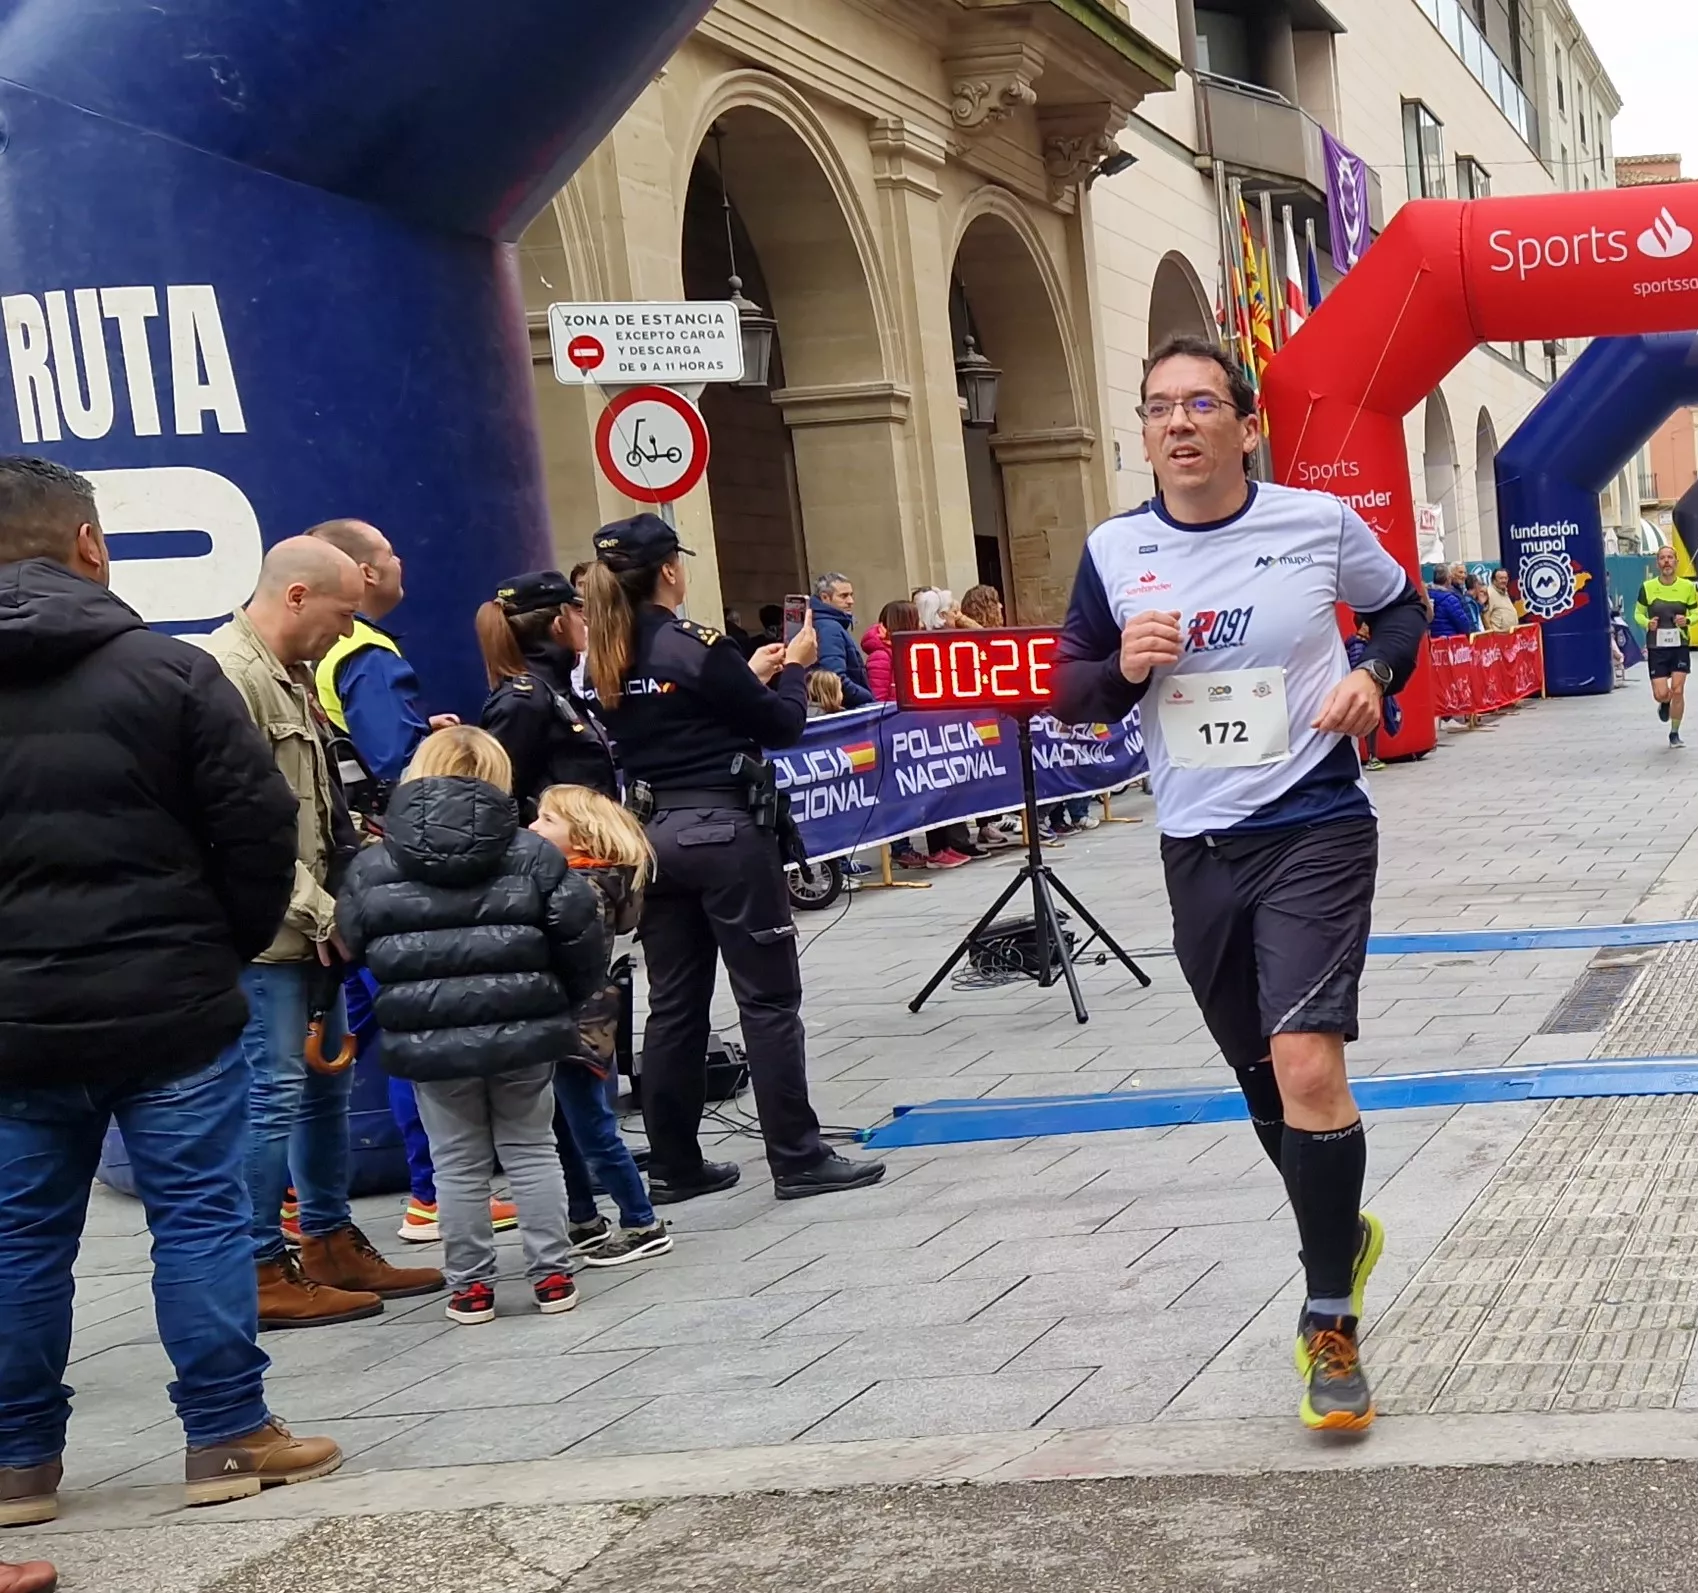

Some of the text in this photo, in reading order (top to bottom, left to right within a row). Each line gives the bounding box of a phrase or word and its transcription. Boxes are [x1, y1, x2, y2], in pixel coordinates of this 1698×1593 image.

[1489, 225, 1628, 280] Sports
[564, 313, 725, 327] ZONA DE ESTANCIA
[616, 330, 725, 341] EXCEPTO CARGA
[618, 346, 701, 356] Y DESCARGA
[2, 284, 248, 443] RUTA
[619, 361, 724, 372] DE 9 A 11 HORAS
[1298, 459, 1360, 484] Sports
[1510, 520, 1579, 540] fundación
[1521, 536, 1566, 555] mupol
[1279, 554, 1315, 566] mupol
[1198, 721, 1249, 745] 172
[895, 749, 1006, 797] NACIONAL
[788, 777, 880, 824] CIONAL
